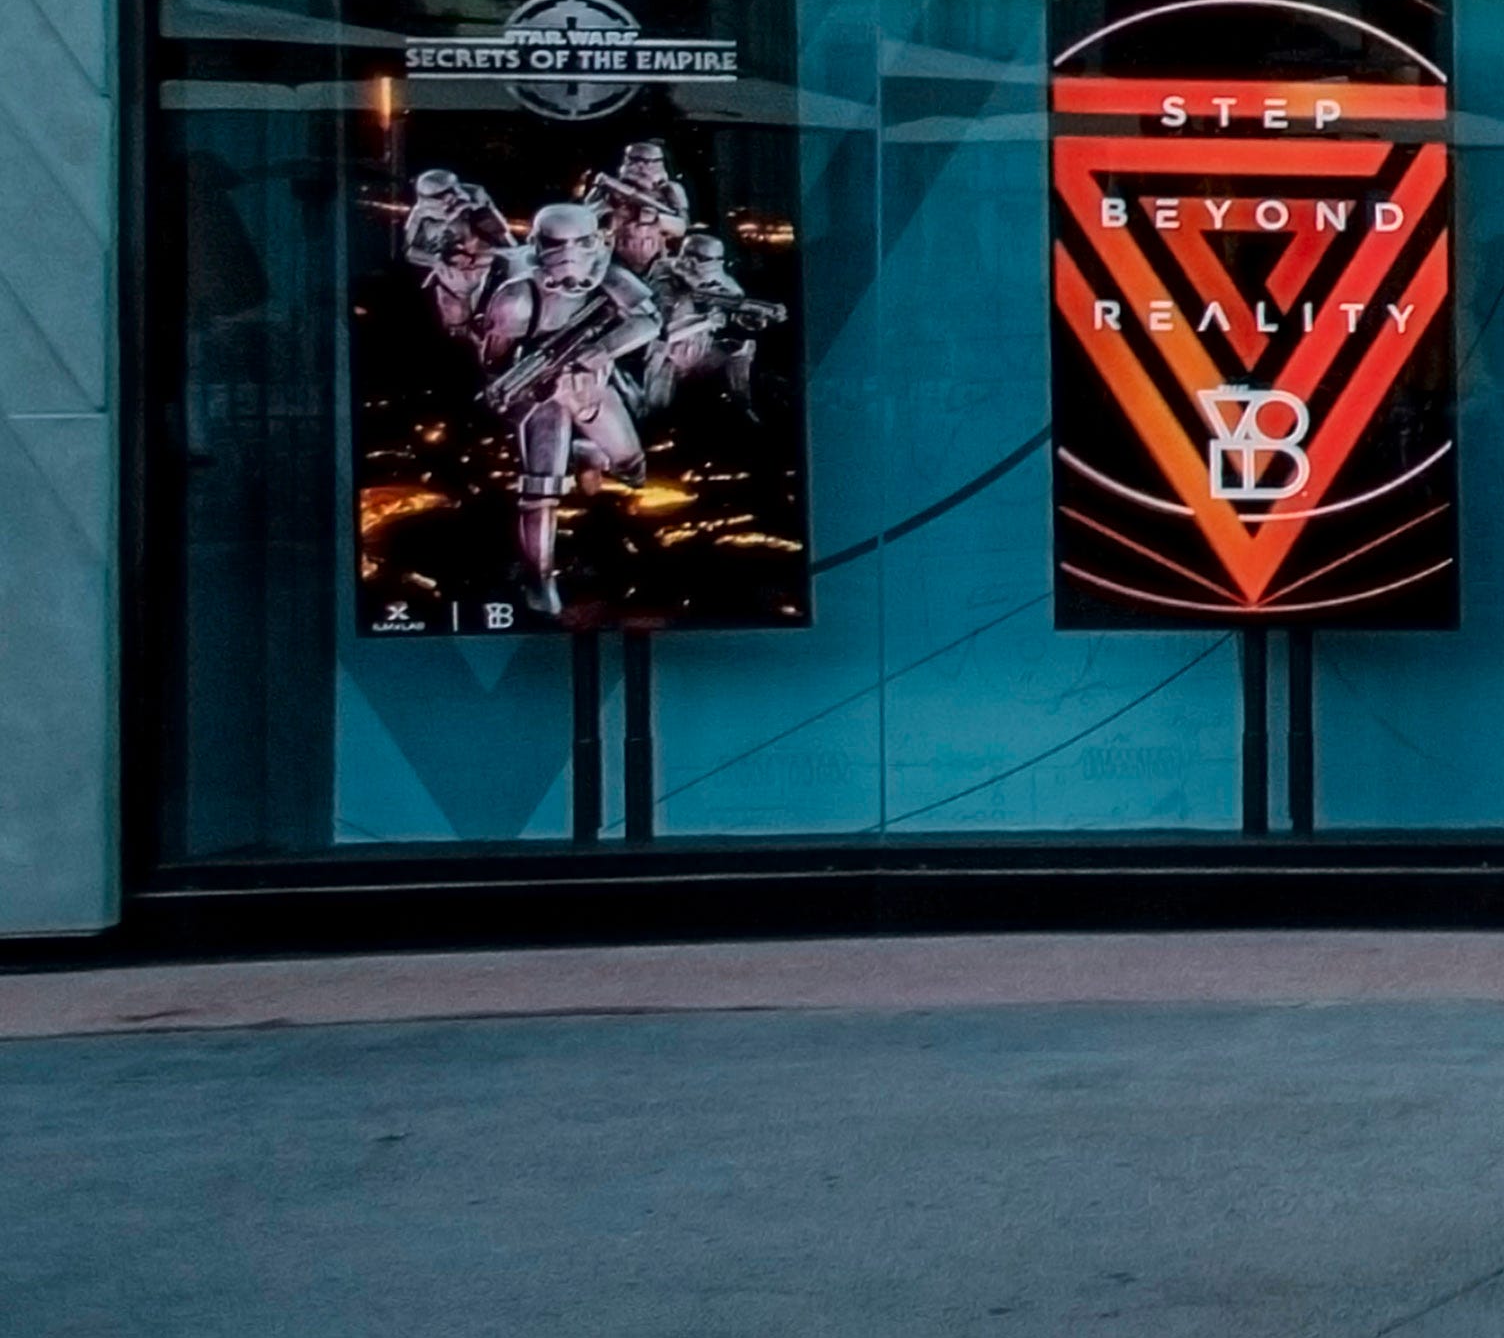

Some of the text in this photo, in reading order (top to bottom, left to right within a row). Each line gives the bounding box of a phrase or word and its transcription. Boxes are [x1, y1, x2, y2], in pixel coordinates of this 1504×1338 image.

[504, 30, 639, 47] STAR WARS
[405, 48, 738, 71] SECRETS OF THE EMPIRE
[1161, 97, 1342, 130] STEP
[1101, 197, 1404, 232] BEYOND
[1093, 300, 1415, 334] REALITY
